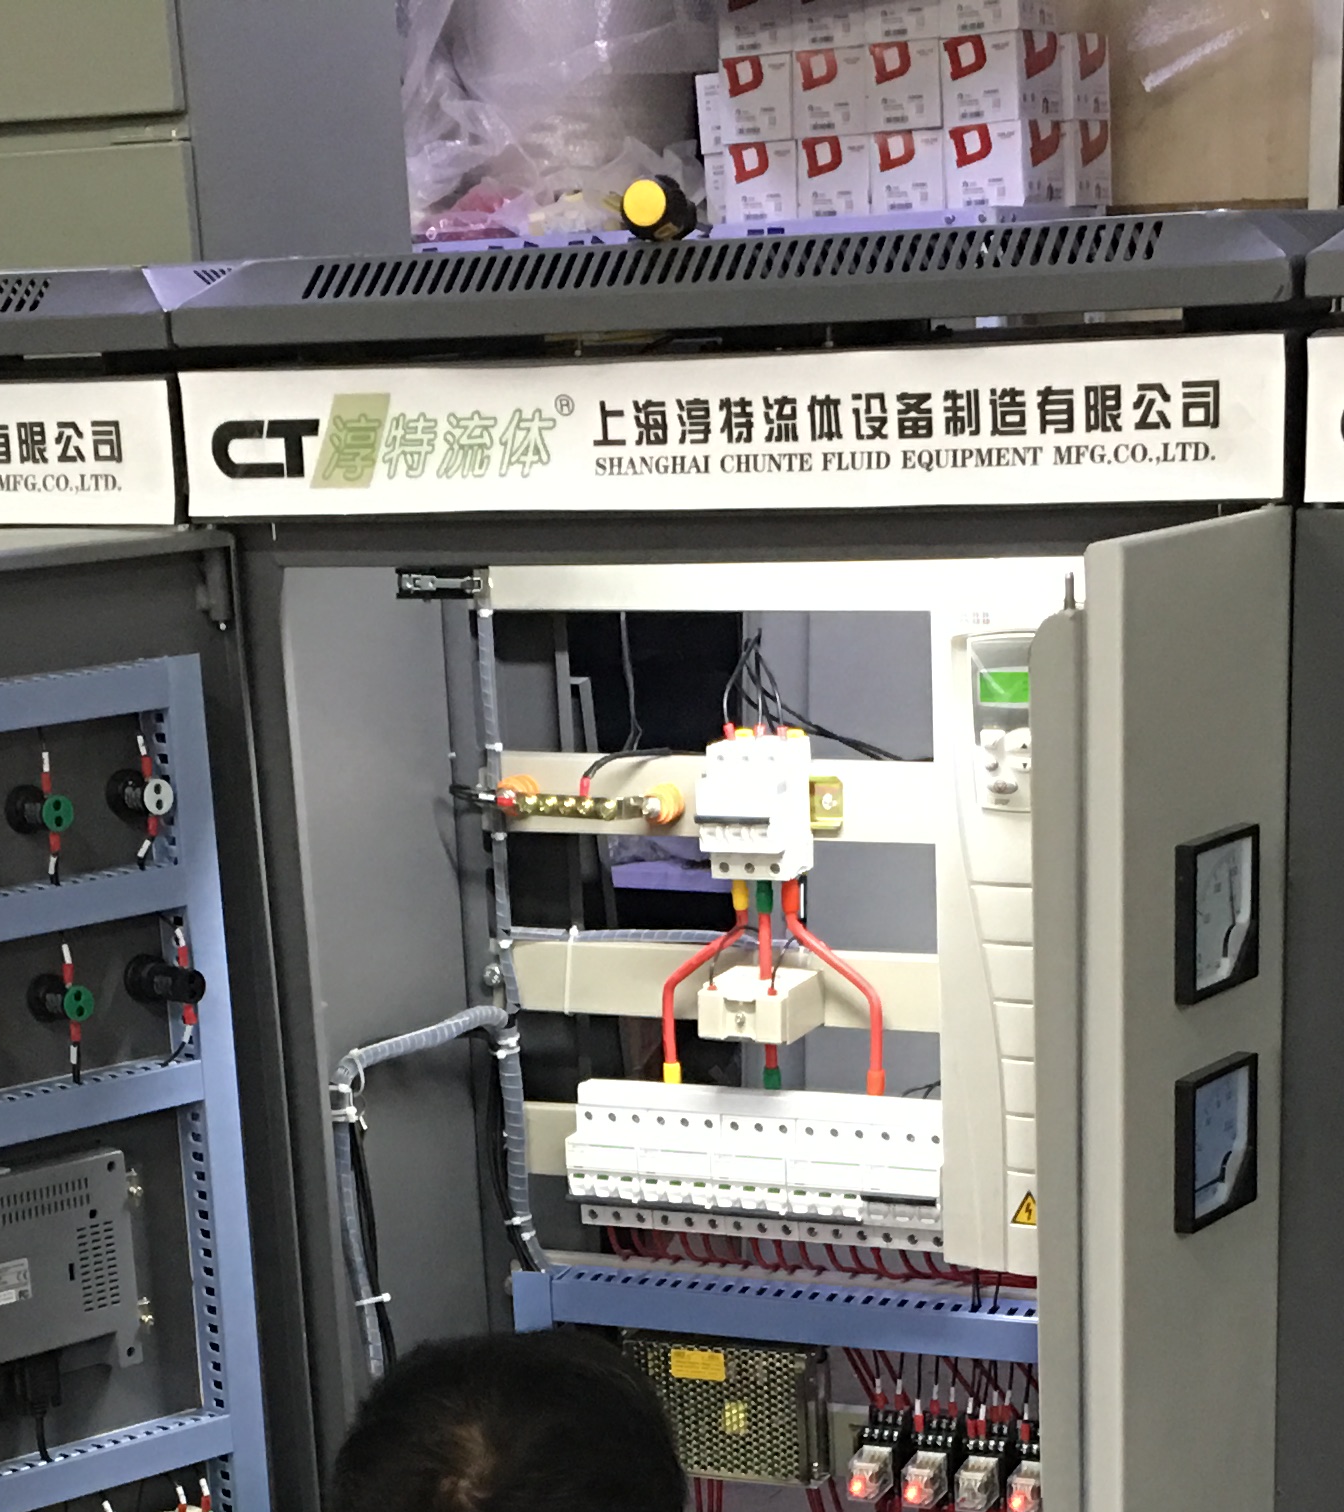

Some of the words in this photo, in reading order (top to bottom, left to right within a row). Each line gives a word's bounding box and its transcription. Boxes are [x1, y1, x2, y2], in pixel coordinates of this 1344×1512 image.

[322, 408, 556, 481] 淳特流体
[593, 379, 1221, 447] 上海淳特流体设备制造有限公司
[212, 419, 320, 479] CT
[594, 454, 710, 476] SHANGHAI
[720, 452, 813, 474] CHUNTE
[821, 451, 891, 472] FLUID
[900, 447, 1043, 472] EQUIPMENT
[1052, 442, 1216, 466] MFG.CO.,LTD.
